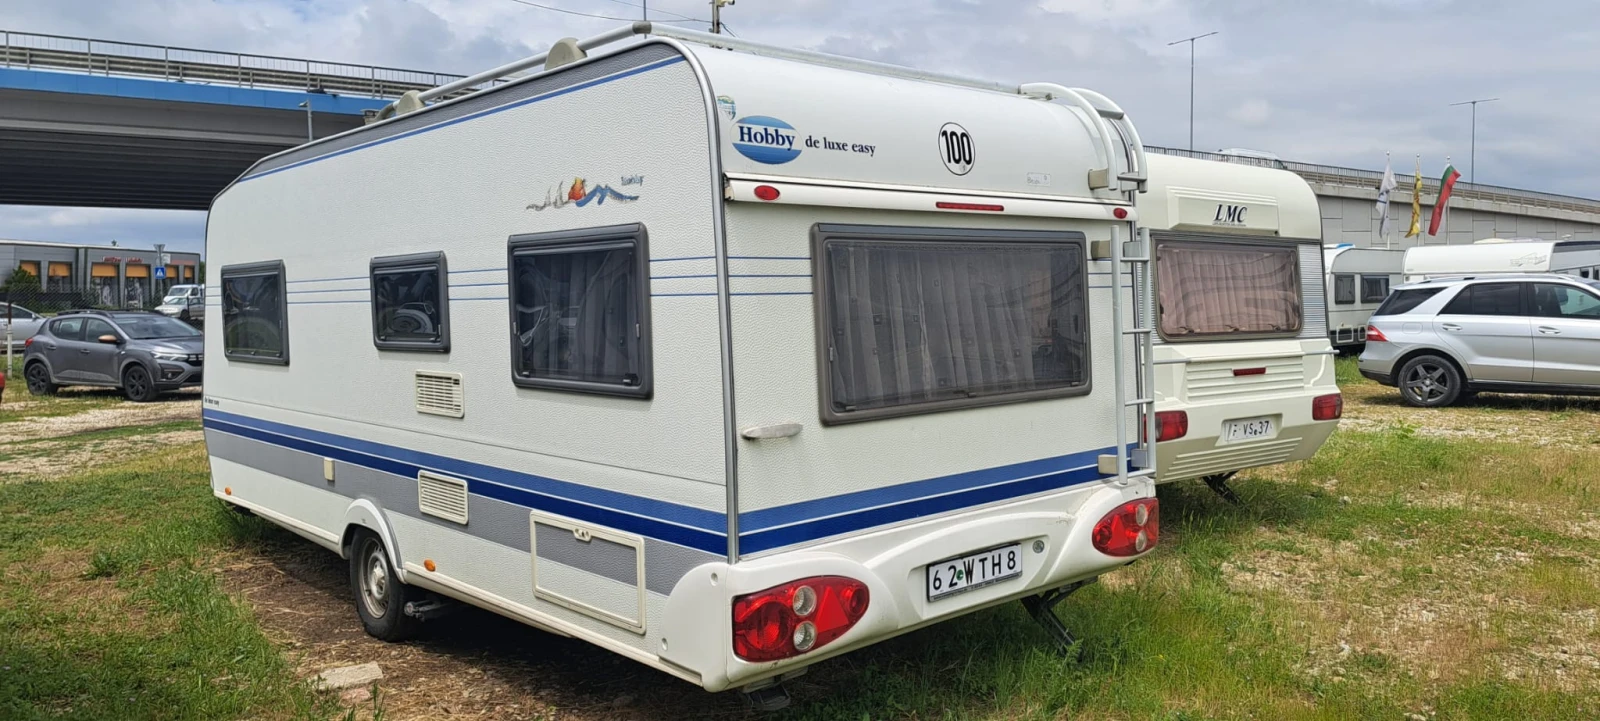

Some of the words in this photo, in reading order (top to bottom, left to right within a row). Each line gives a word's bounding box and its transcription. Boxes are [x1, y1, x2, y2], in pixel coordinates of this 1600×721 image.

[738, 126, 795, 151] Hobby
[805, 135, 820, 148] de
[823, 137, 848, 151] luxe
[851, 143, 876, 157] easy
[941, 130, 972, 165] 100
[1213, 204, 1247, 222] LMC
